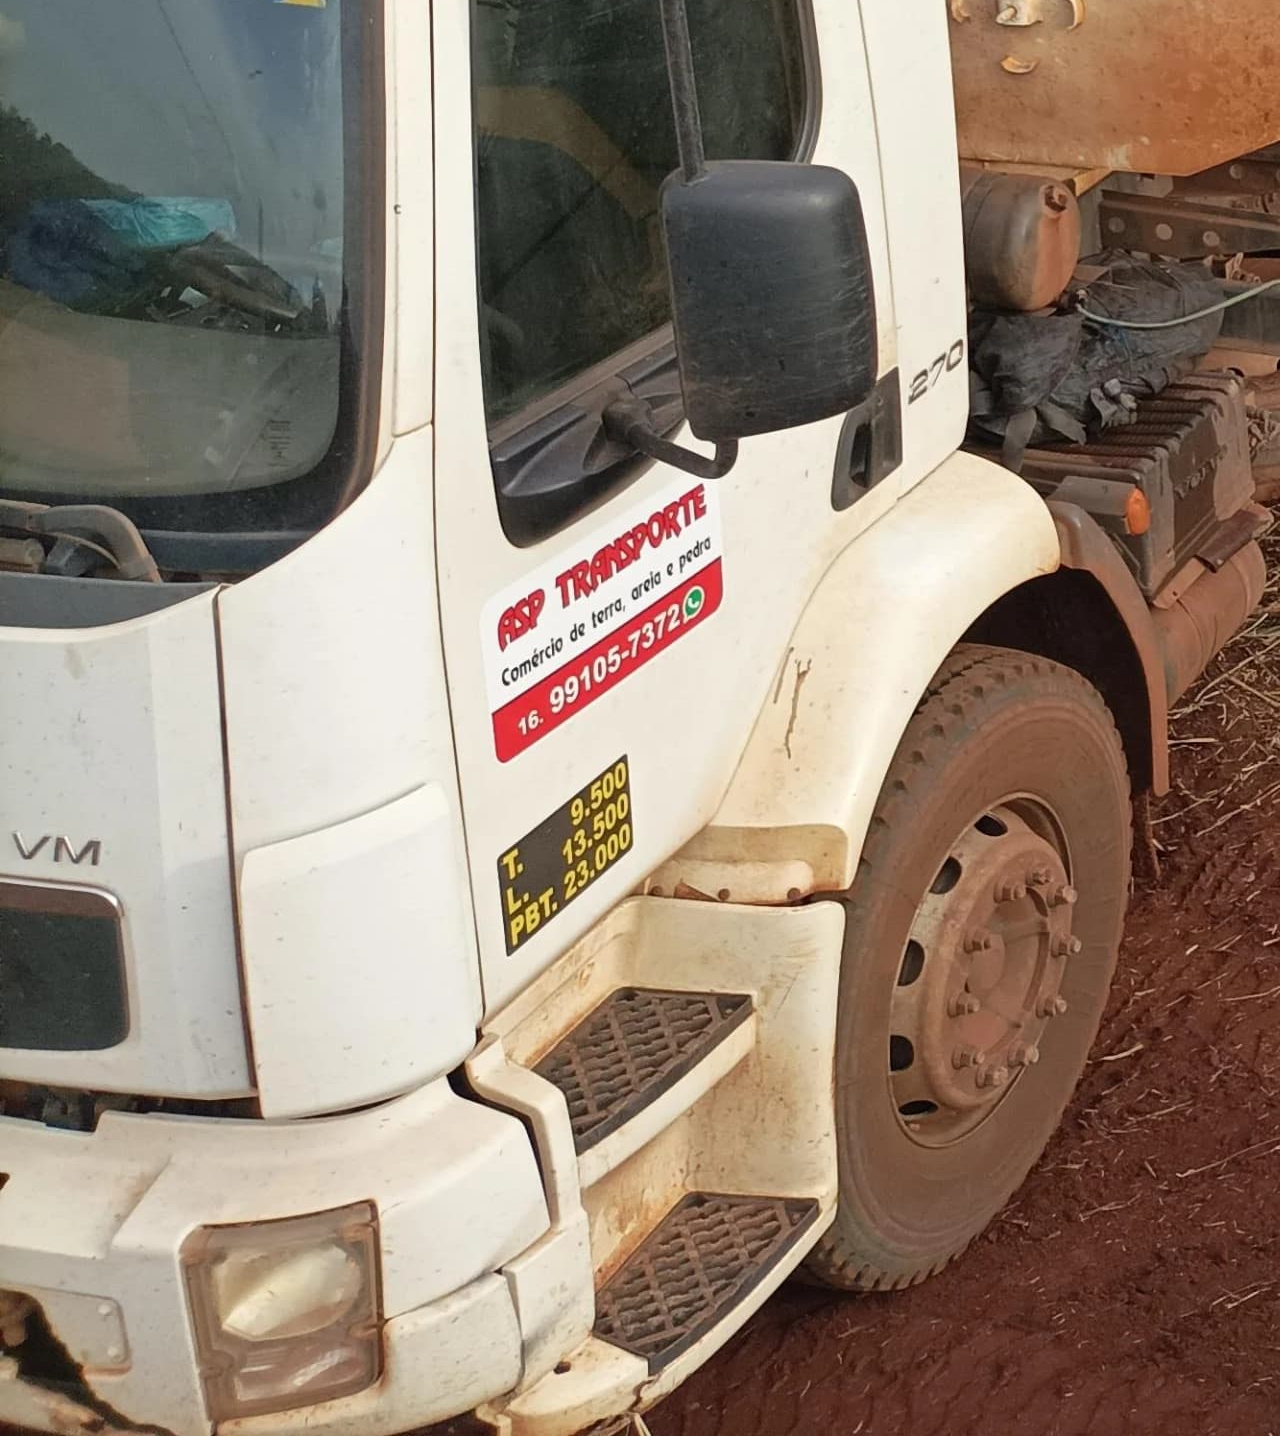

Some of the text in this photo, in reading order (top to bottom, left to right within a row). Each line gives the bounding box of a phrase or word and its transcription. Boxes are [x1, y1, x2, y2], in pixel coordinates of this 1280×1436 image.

[908, 338, 964, 405] 270
[497, 483, 707, 652] ASP TRANSPORTE
[501, 536, 711, 686] Comércio de terra, areia e pedra
[518, 604, 680, 735] 16. 99105-7372
[12, 830, 102, 866] VM
[502, 762, 627, 880] T. 9.500
[506, 793, 629, 915] L. 13.500
[510, 823, 631, 946] PBT. 23.000
